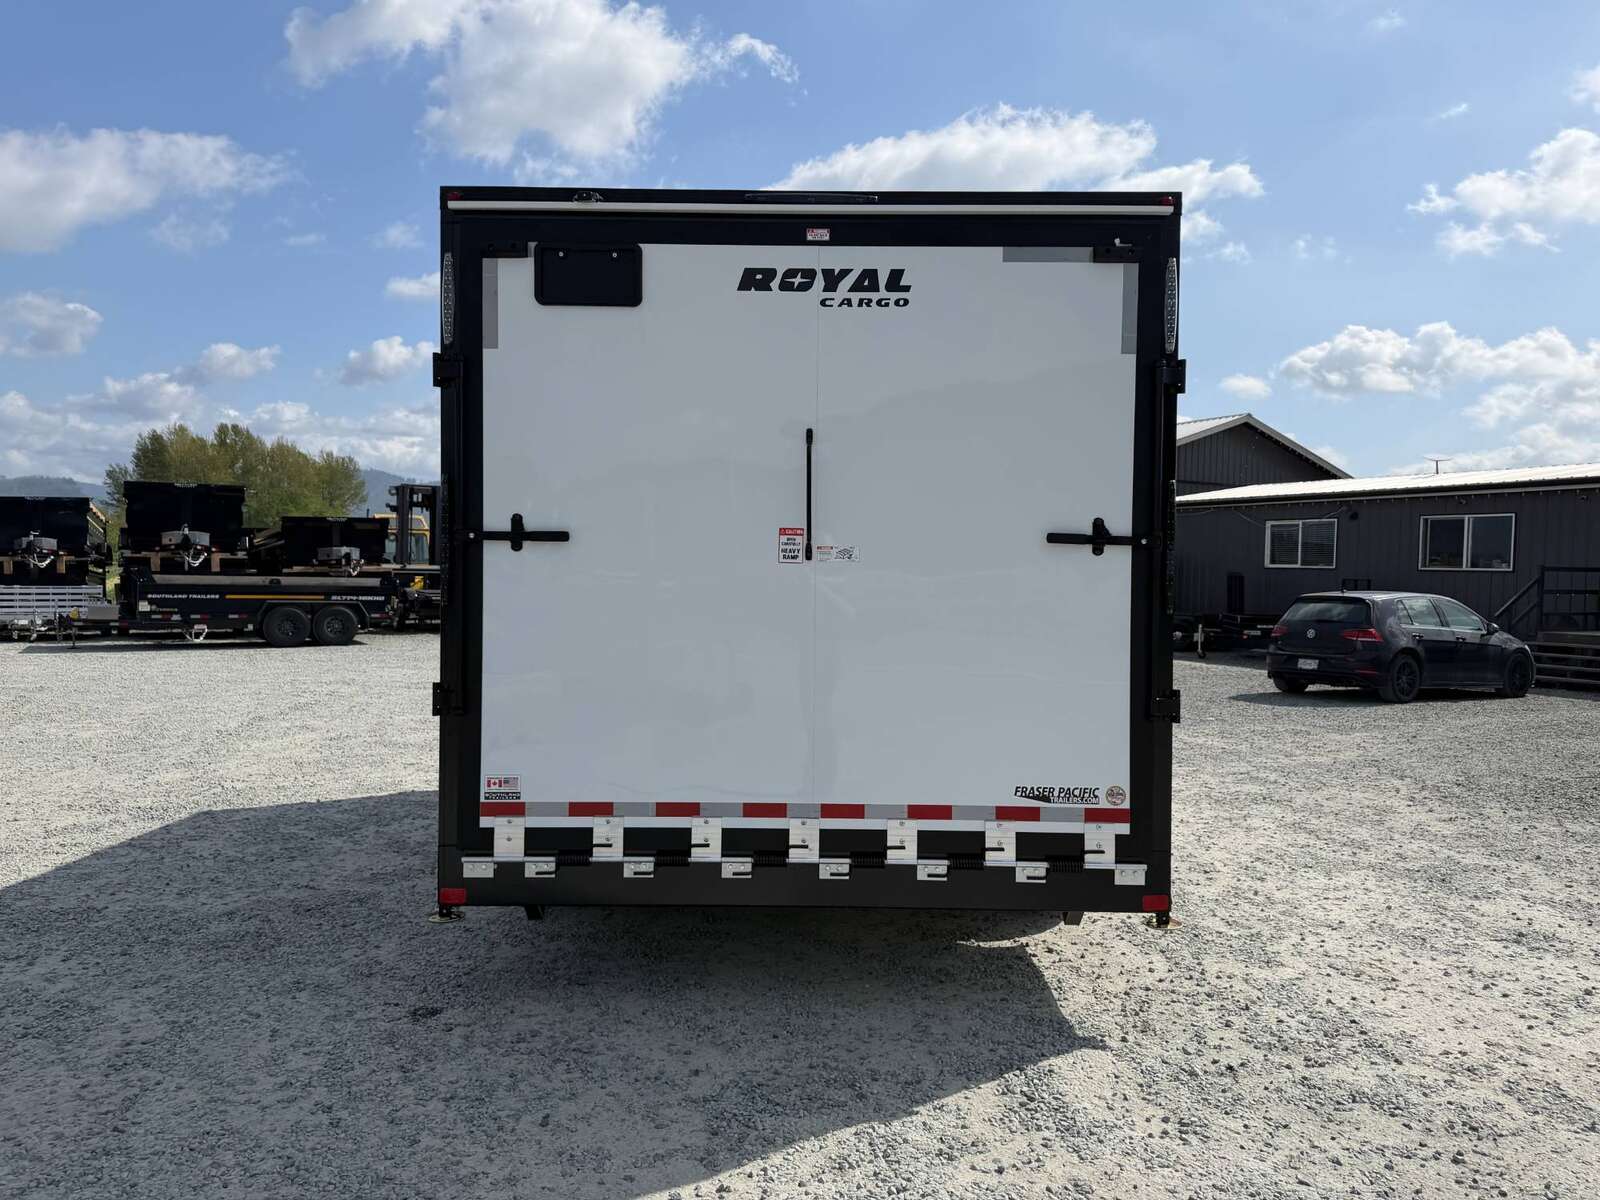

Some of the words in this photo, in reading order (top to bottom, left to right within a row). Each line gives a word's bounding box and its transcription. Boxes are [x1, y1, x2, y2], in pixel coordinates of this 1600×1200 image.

[737, 267, 912, 292] ROYAL
[819, 298, 910, 308] CARGO
[1014, 786, 1055, 798] FRASER
[1057, 787, 1100, 799] PACIFIC
